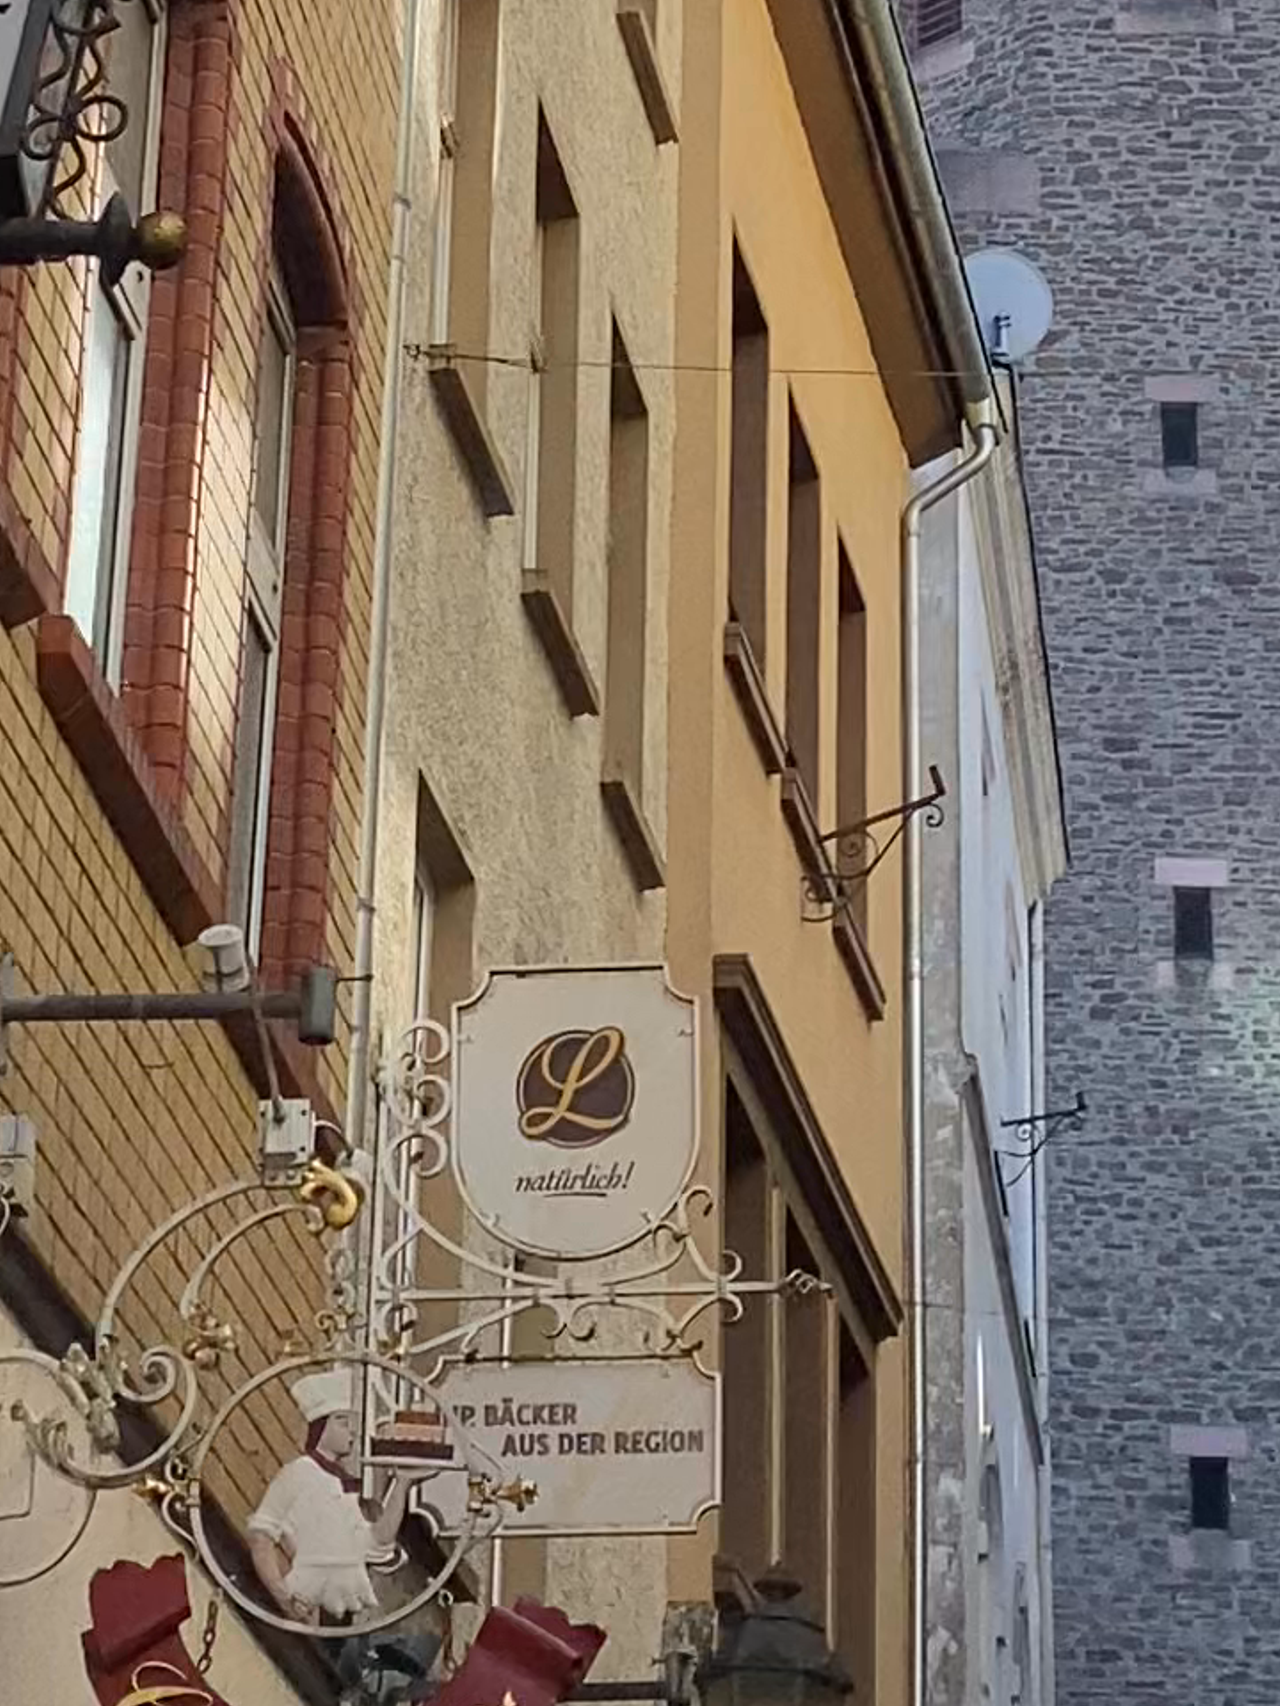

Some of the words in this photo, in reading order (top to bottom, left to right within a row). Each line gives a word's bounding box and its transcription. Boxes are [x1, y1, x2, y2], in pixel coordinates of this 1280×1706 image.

[515, 1159, 635, 1194] natürlich!
[484, 1397, 578, 1428] BÄCKER
[500, 1432, 552, 1458] AUS
[557, 1430, 607, 1456] DER
[613, 1428, 705, 1455] REGION
